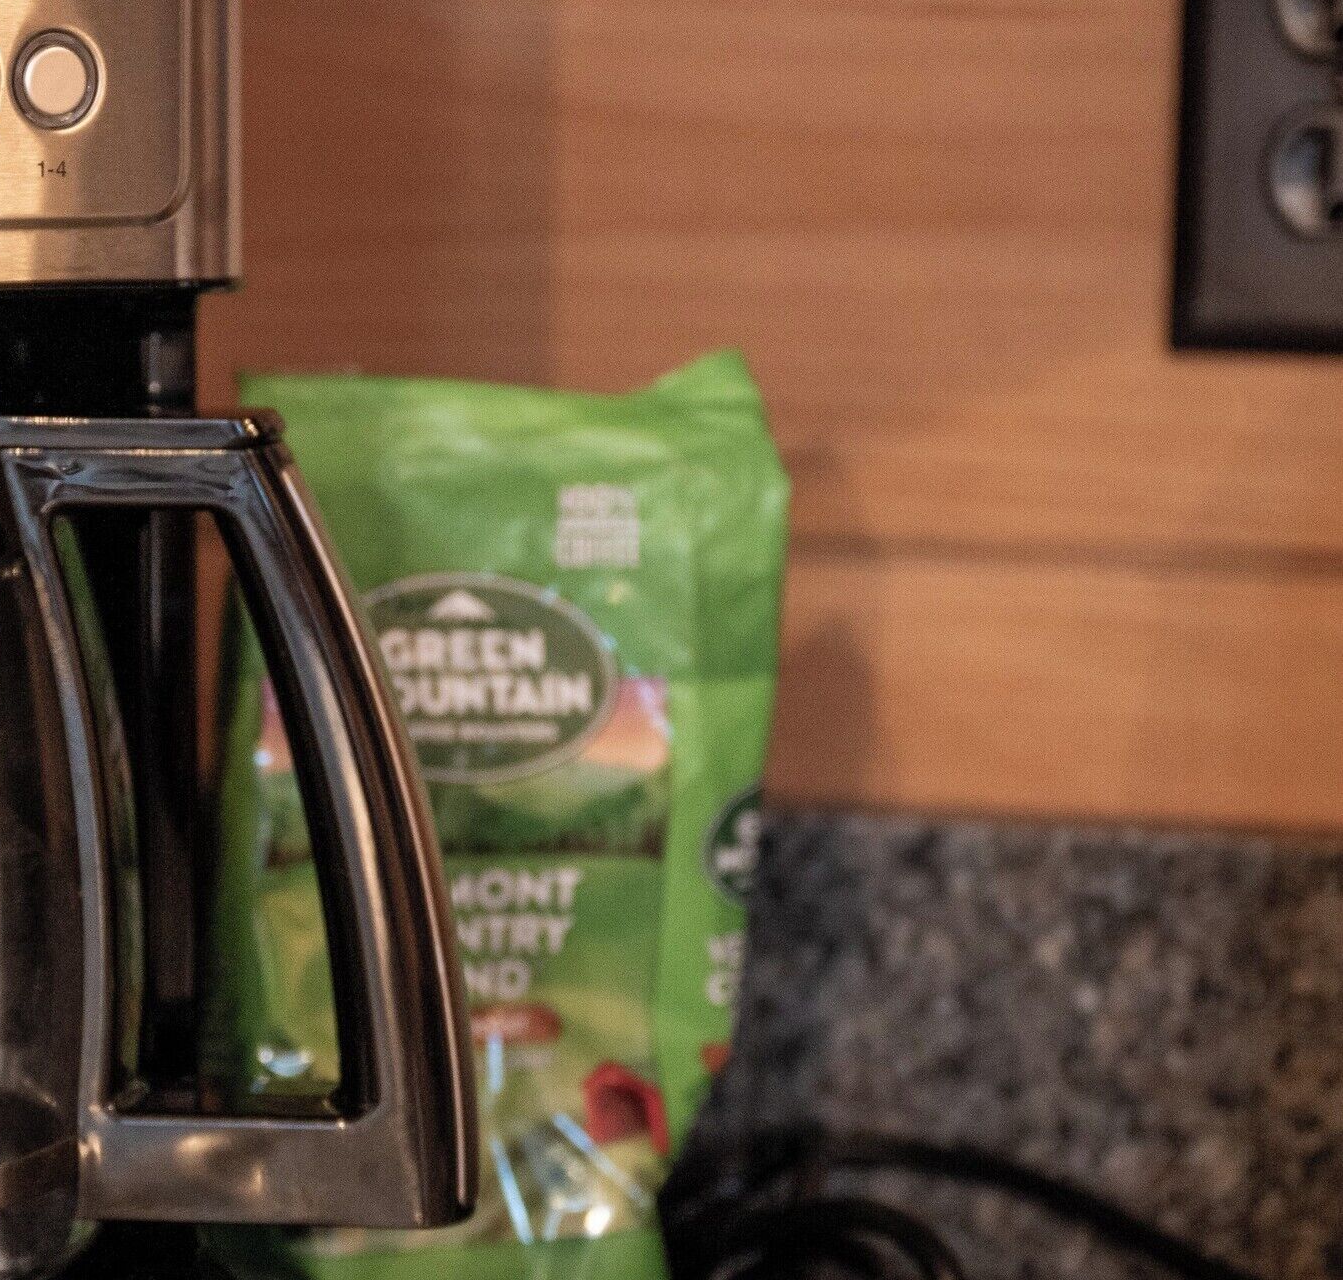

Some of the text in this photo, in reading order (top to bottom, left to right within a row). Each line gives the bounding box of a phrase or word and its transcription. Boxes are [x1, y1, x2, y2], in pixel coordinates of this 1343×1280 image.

[37, 160, 67, 177] 1-4
[380, 629, 545, 670] GREEN
[393, 673, 592, 712] OUNTAIN
